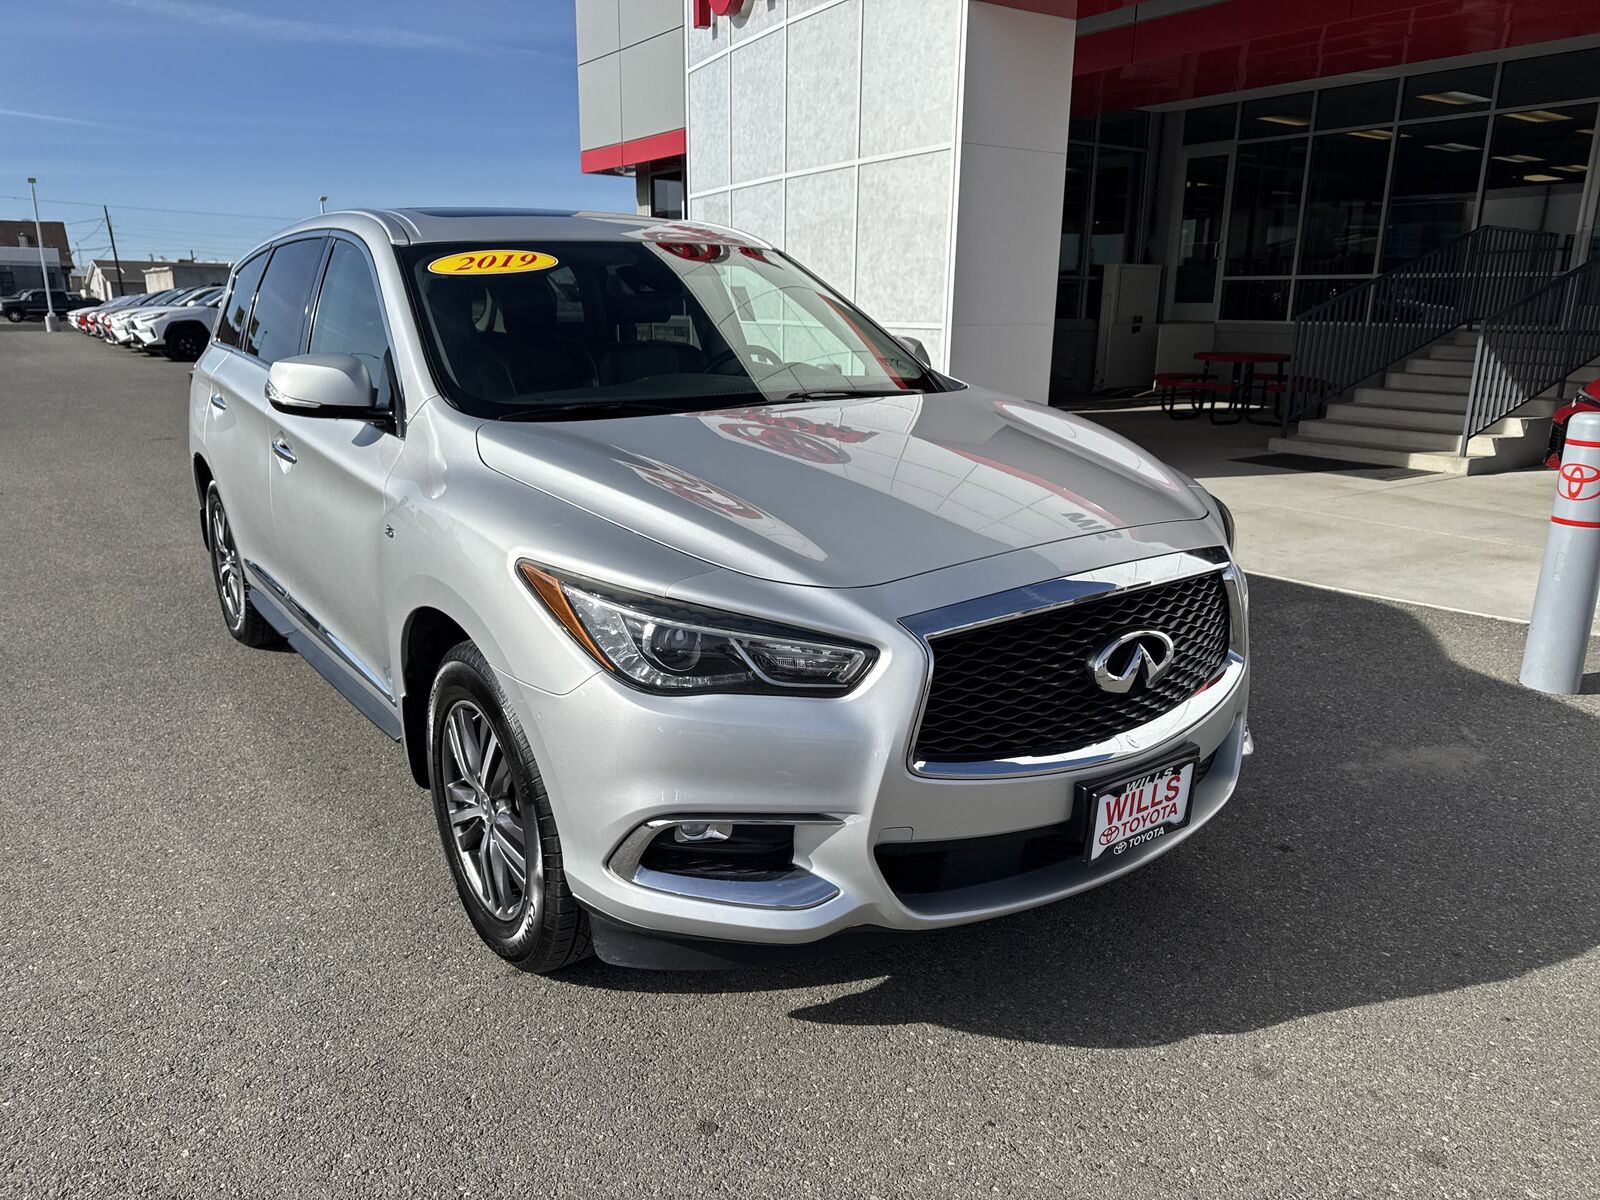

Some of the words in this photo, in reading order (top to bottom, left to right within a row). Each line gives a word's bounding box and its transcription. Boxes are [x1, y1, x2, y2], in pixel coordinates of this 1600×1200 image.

[455, 254, 538, 271] 2019
[1126, 767, 1173, 793] WILLS
[1105, 775, 1181, 826] WILLS
[1121, 802, 1178, 836] TOYOTA
[1129, 826, 1165, 848] TOYOTA
